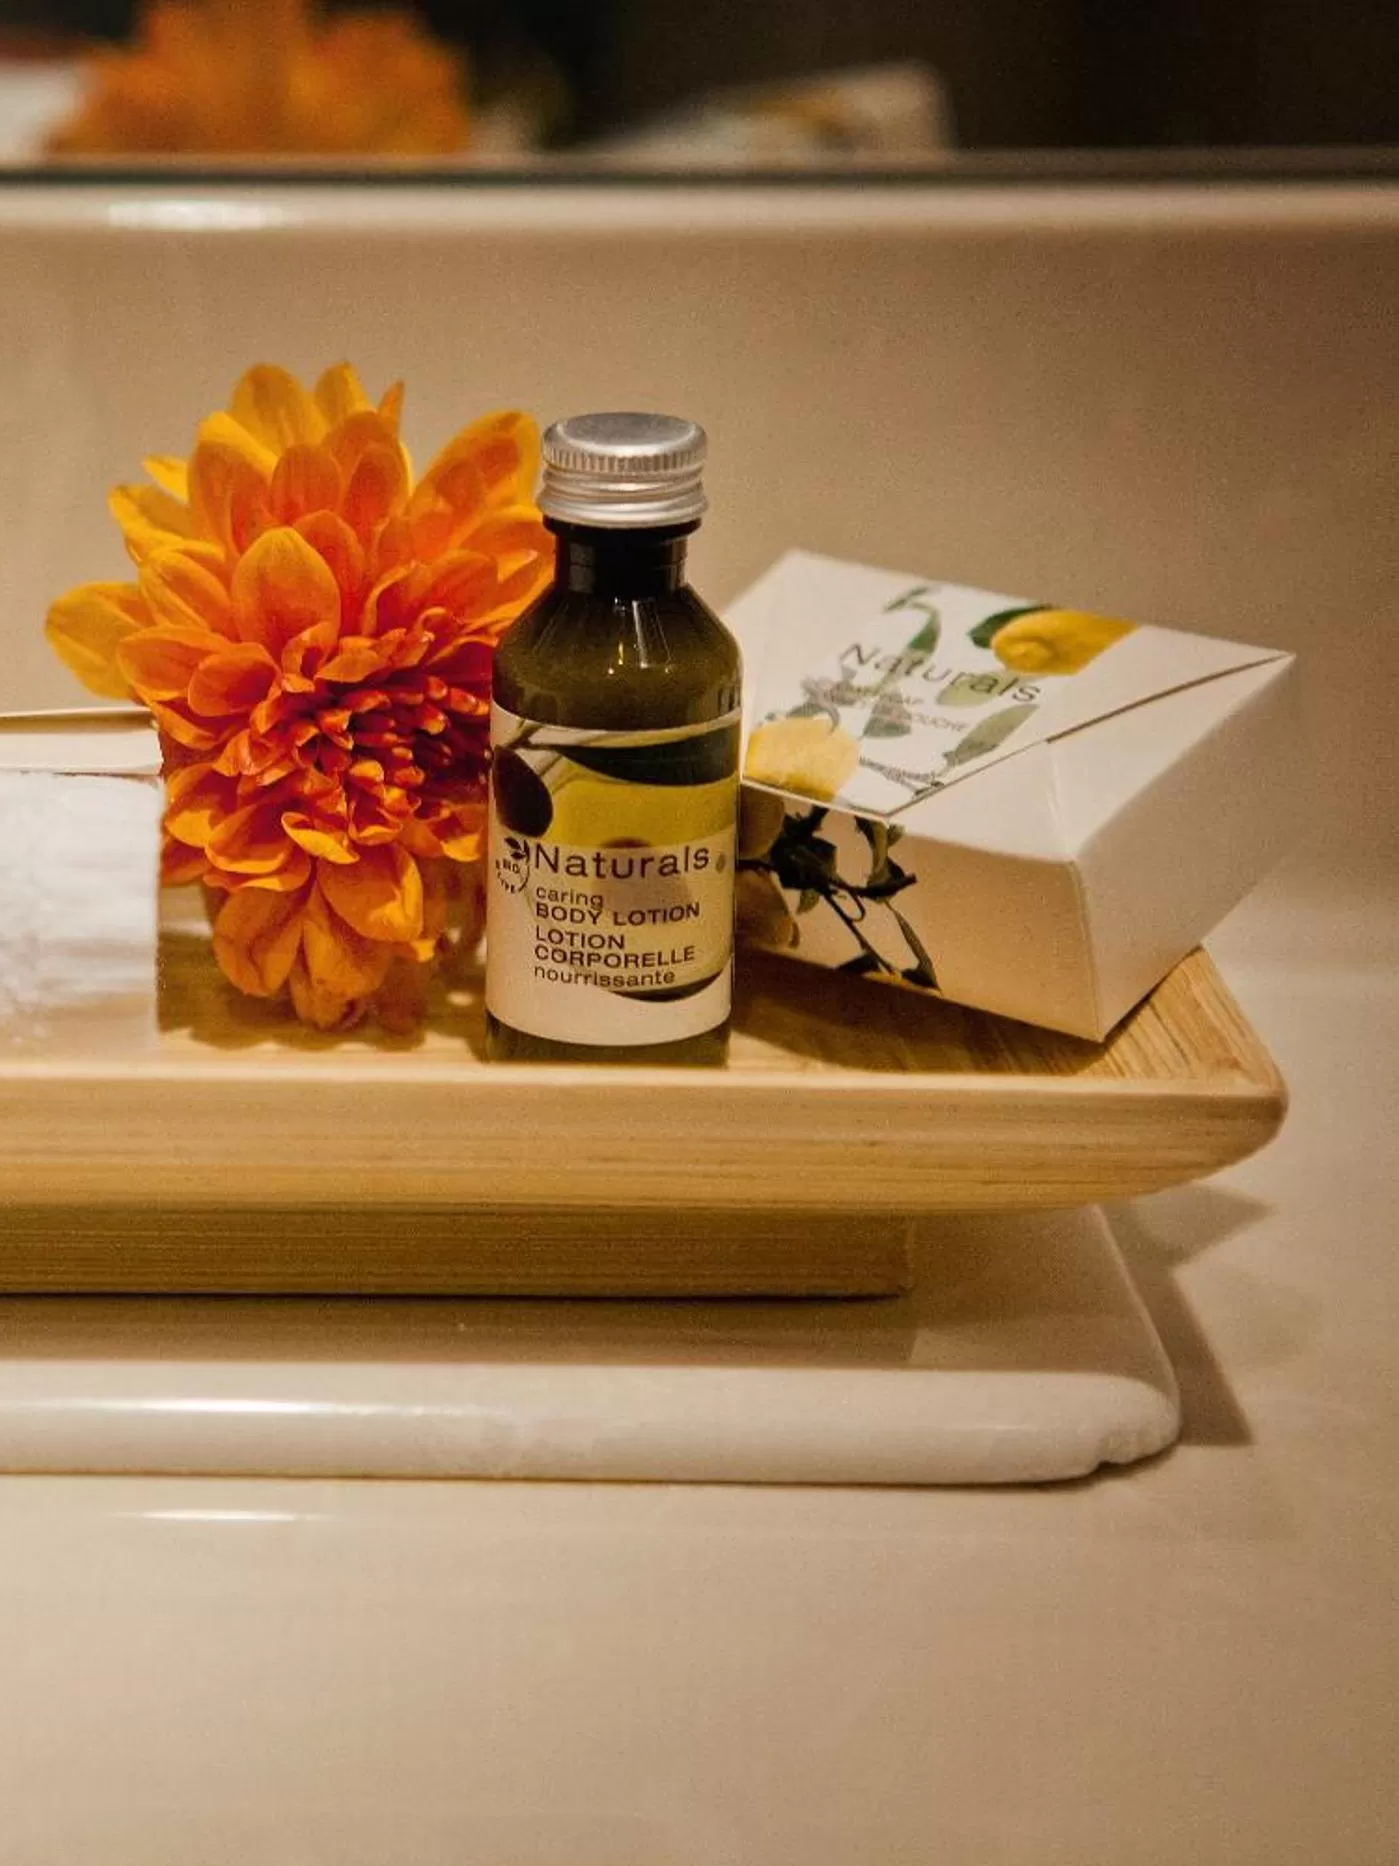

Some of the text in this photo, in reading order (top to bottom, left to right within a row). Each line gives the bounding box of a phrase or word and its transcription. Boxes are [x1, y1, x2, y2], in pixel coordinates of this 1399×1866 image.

[838, 642, 1041, 702] Naturals
[535, 843, 710, 879] Naturals
[536, 886, 604, 910] caring
[536, 902, 700, 926] BODY LOTION
[535, 926, 625, 950] LOTION
[535, 945, 696, 968] CORPORELLE
[534, 967, 676, 988] nourrissante
